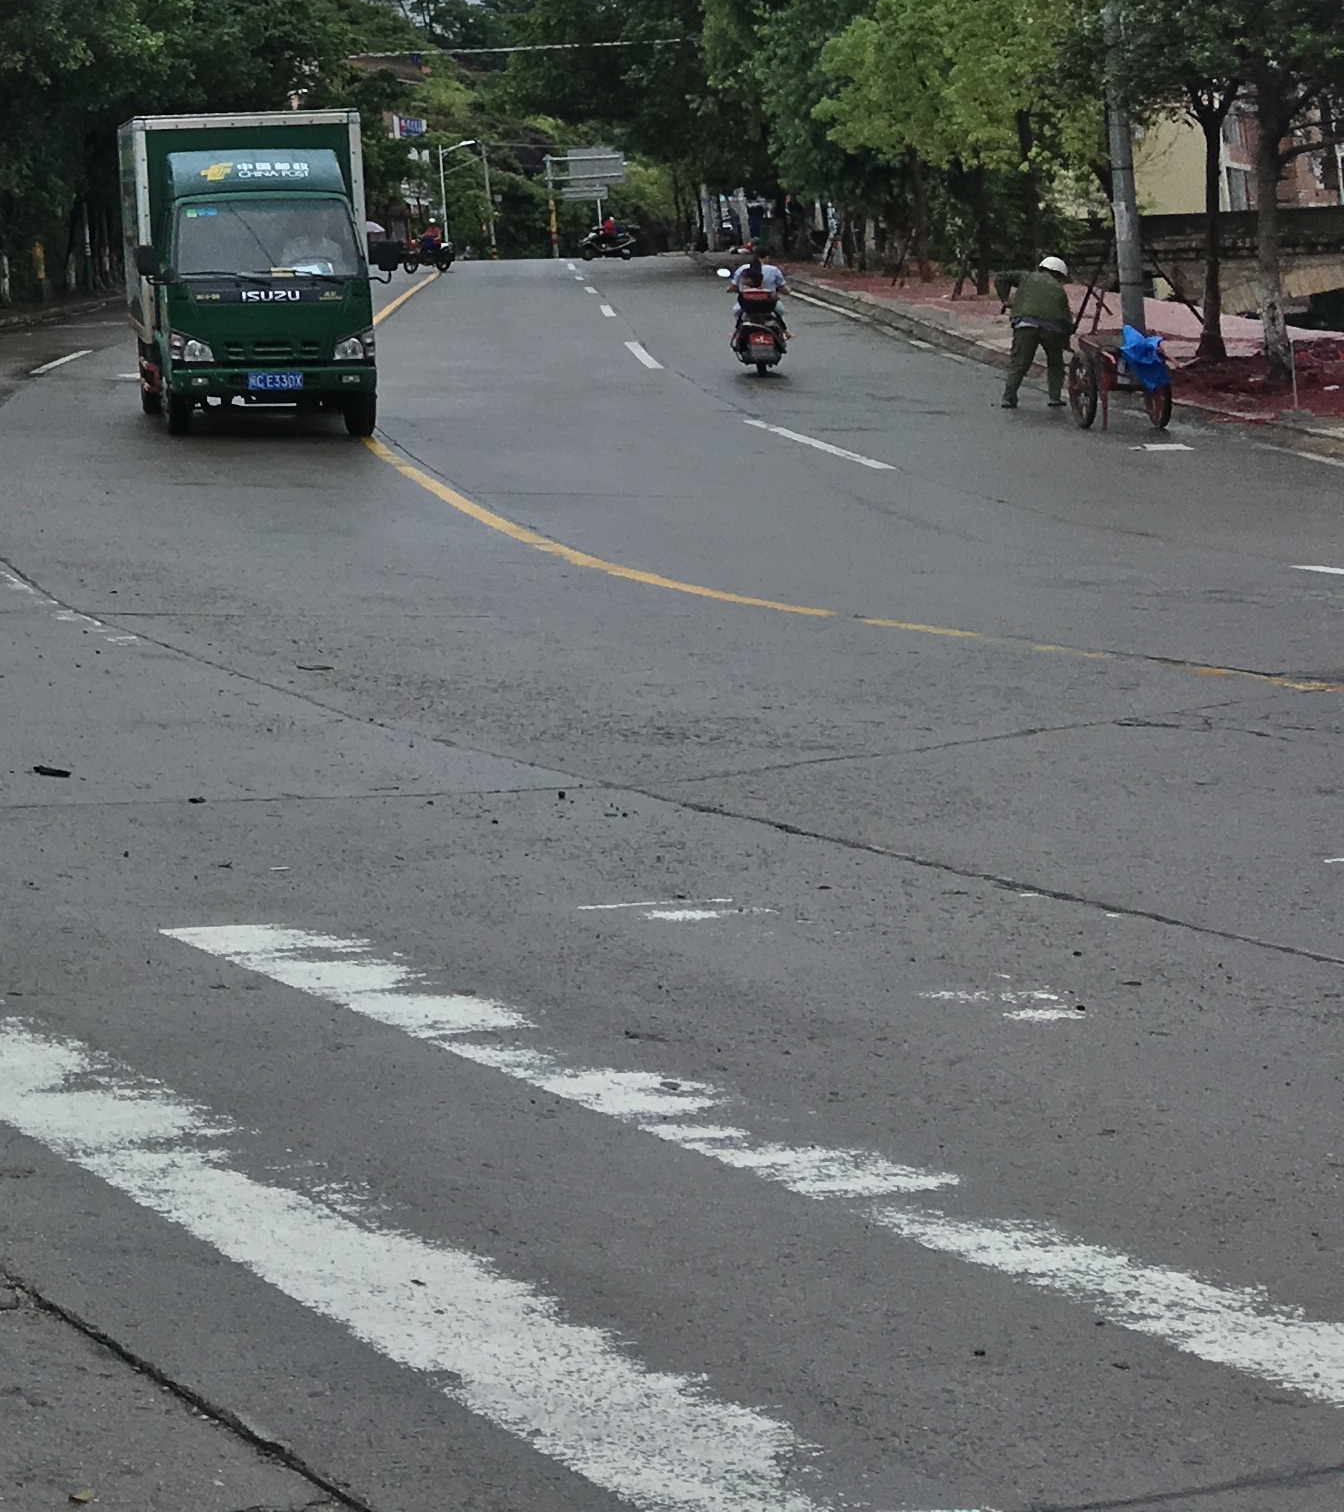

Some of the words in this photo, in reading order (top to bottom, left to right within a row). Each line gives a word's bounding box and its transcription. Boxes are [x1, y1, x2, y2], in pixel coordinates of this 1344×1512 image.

[238, 170, 279, 178] CHINA
[281, 170, 310, 178] POST
[242, 290, 300, 302] ISUZU
